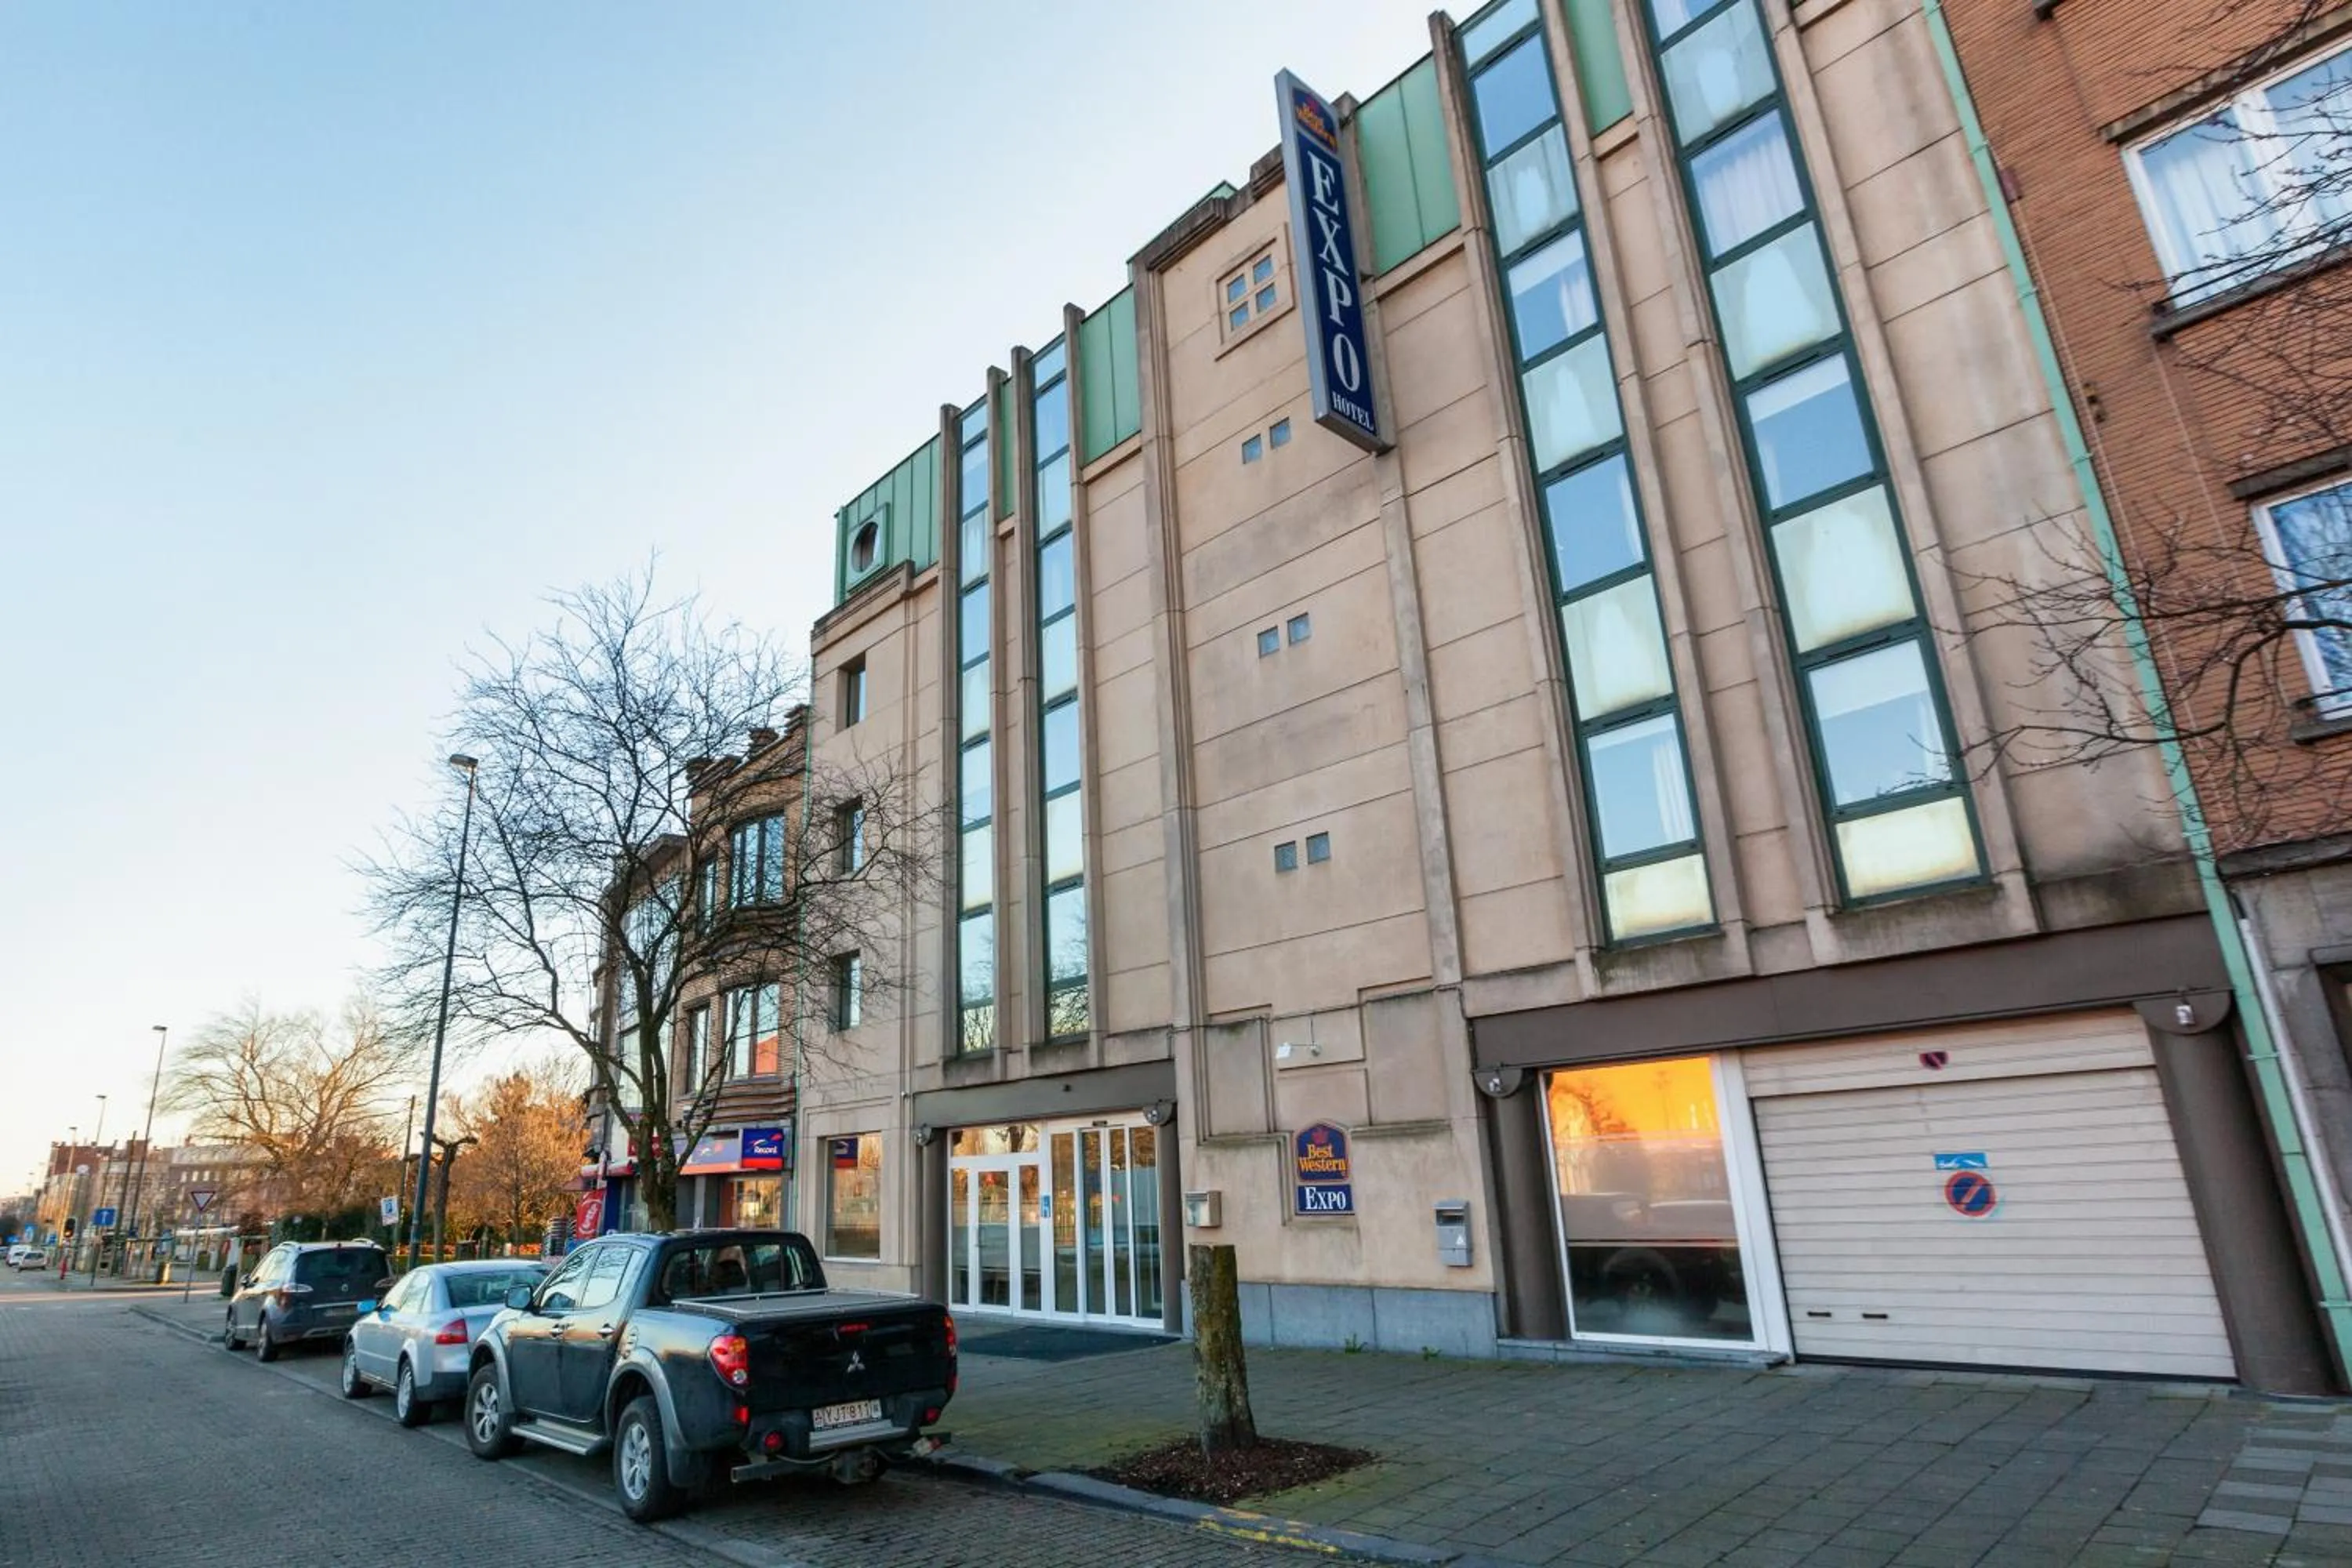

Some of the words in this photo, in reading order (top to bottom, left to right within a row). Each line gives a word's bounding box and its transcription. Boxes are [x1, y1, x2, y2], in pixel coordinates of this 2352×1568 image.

[1308, 151, 1361, 392] EXPO
[1332, 390, 1374, 431] HOTEL
[1299, 1156, 1346, 1171] Western
[1307, 1144, 1333, 1159] Best
